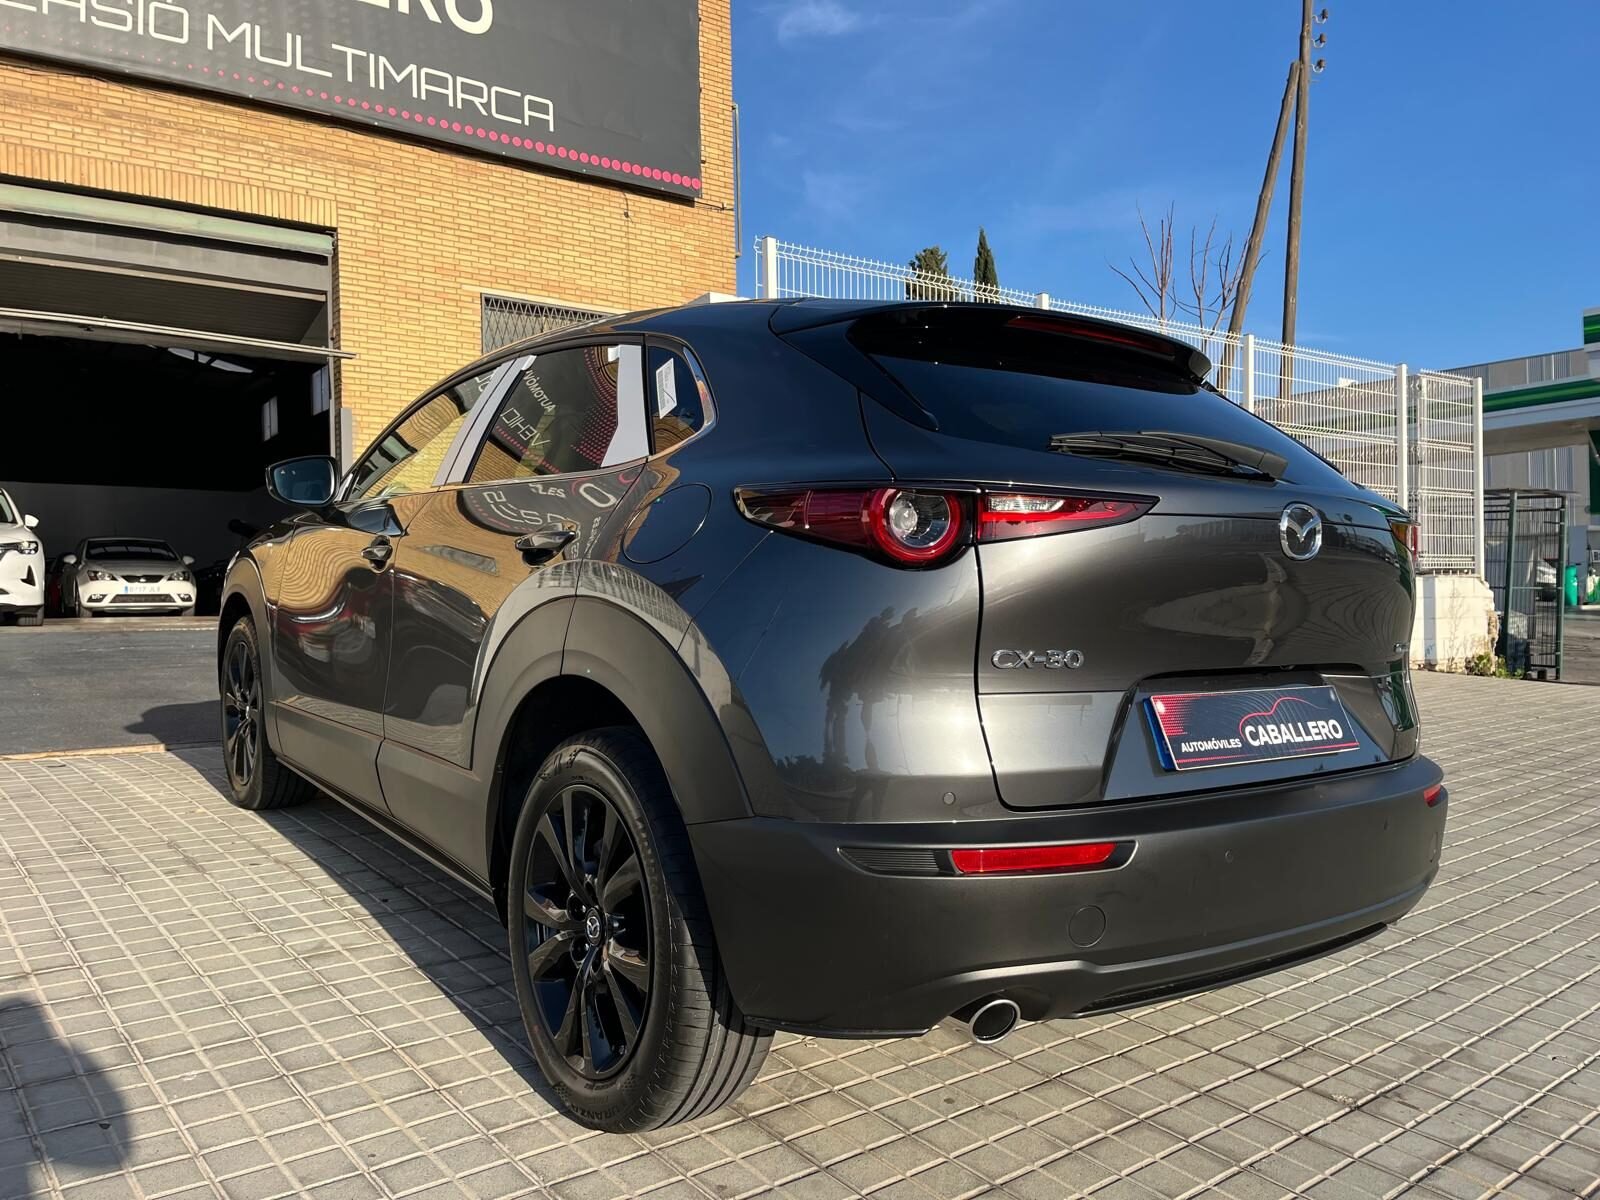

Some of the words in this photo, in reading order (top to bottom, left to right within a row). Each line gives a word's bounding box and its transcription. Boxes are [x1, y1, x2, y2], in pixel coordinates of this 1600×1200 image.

[207, 13, 554, 132] MULTIMARCA
[991, 649, 1085, 669] CX-30
[1181, 737, 1242, 753] AUTOMÓVILES
[1244, 719, 1343, 747] CABALLERO
